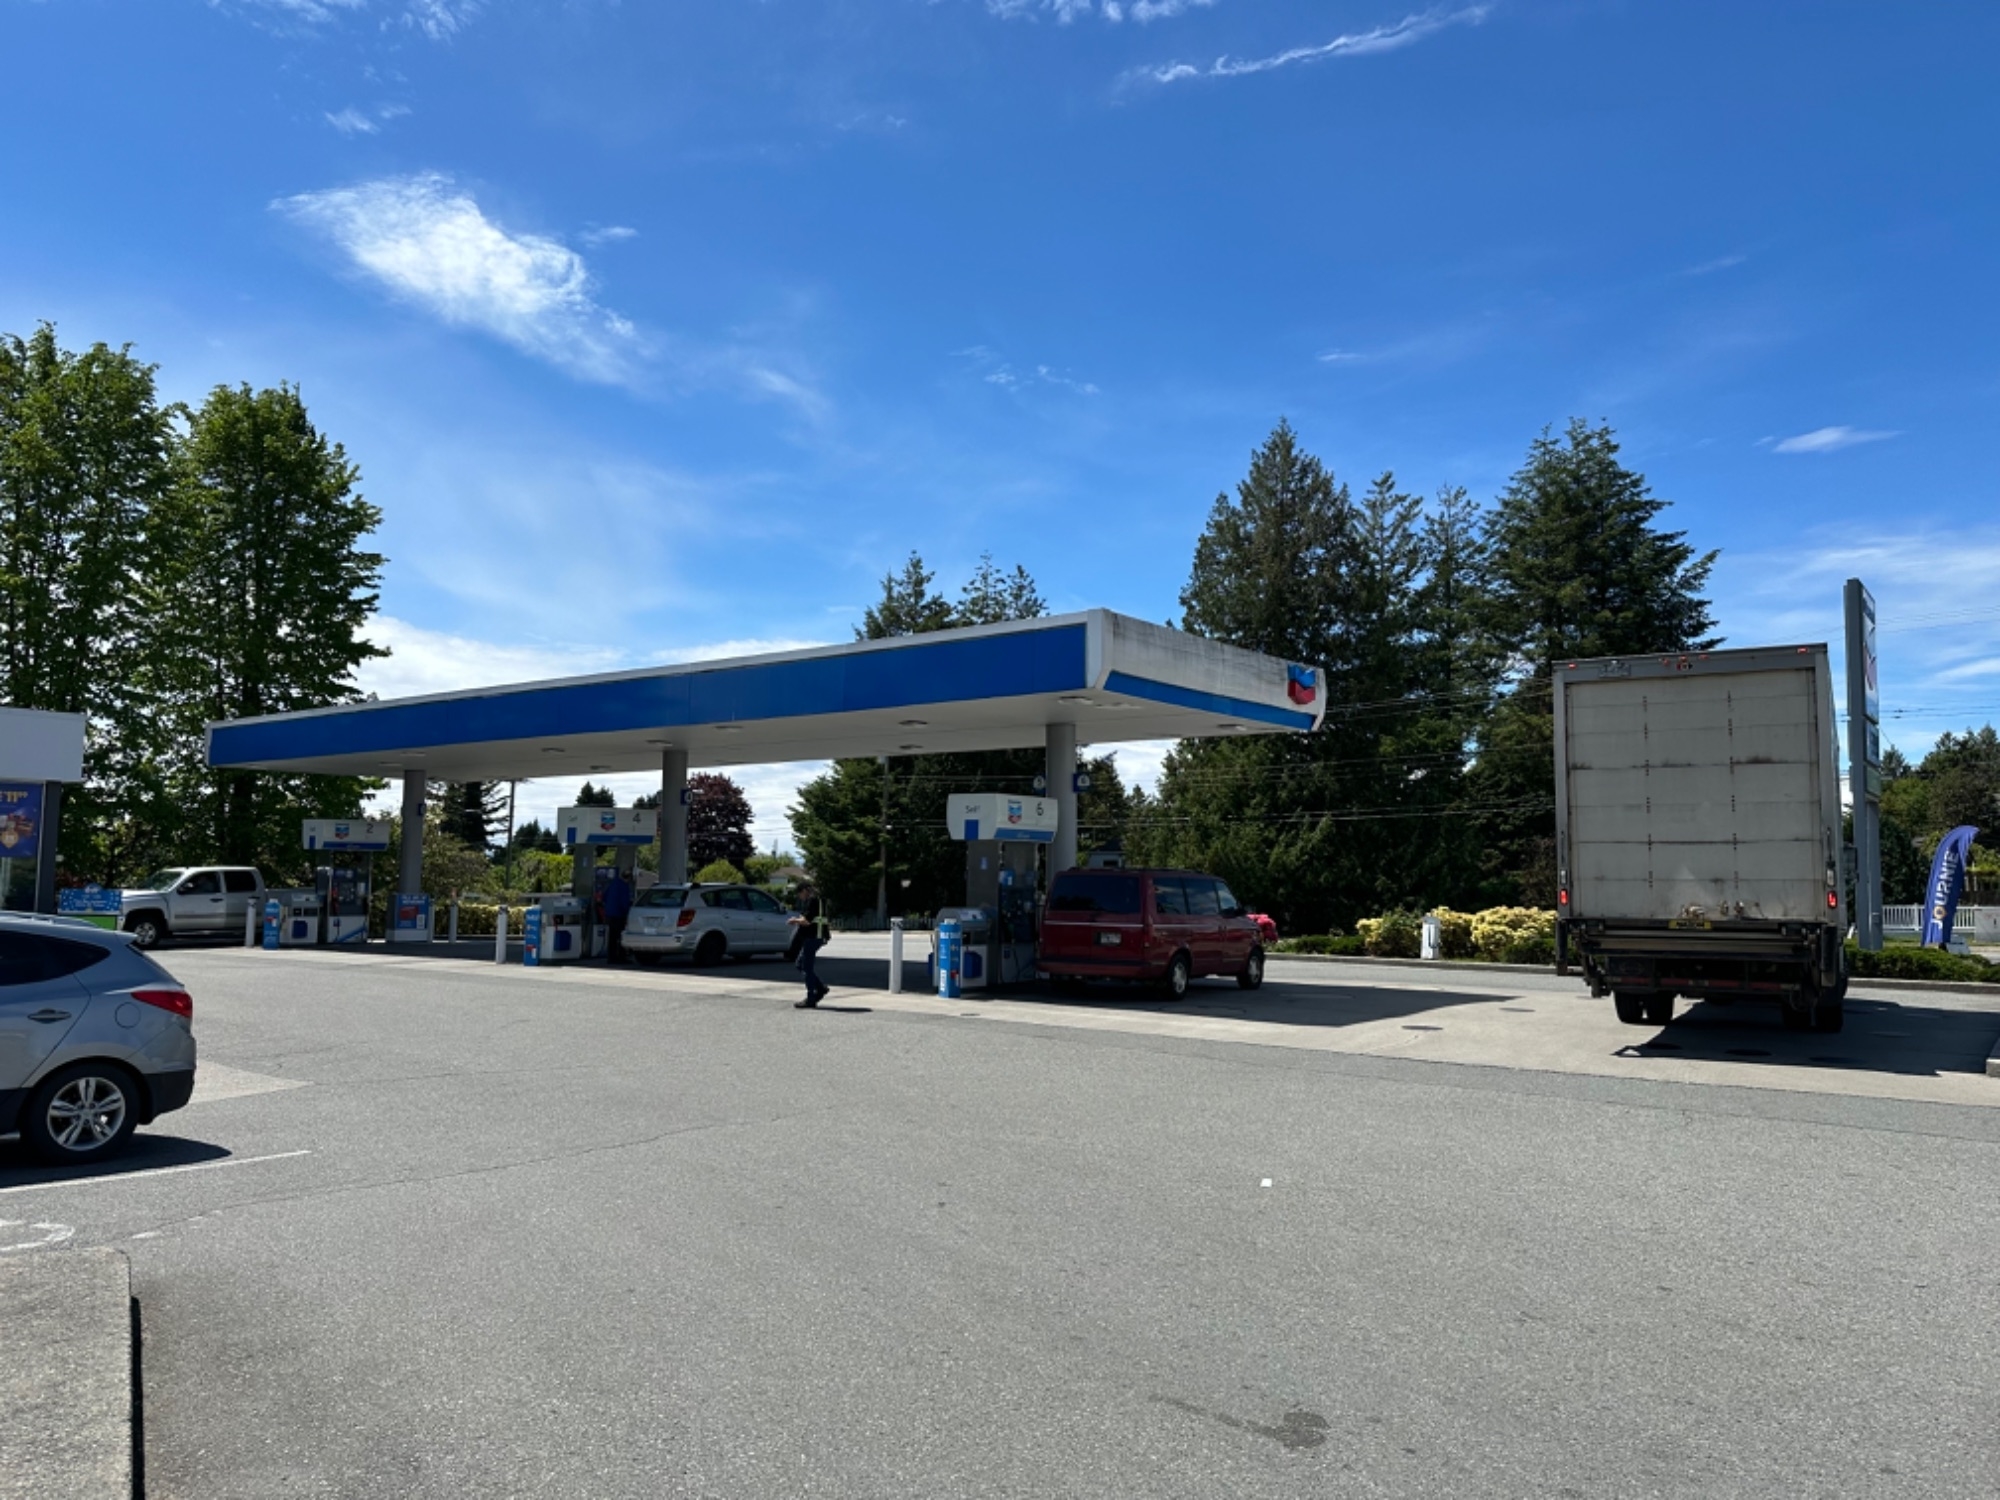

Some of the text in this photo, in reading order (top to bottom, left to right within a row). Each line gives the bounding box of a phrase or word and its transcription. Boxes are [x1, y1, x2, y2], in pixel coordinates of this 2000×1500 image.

[1036, 801, 1044, 816] 6
[632, 813, 641, 824] 4
[366, 823, 374, 834] 2
[1931, 850, 1959, 930] JOURNIE
